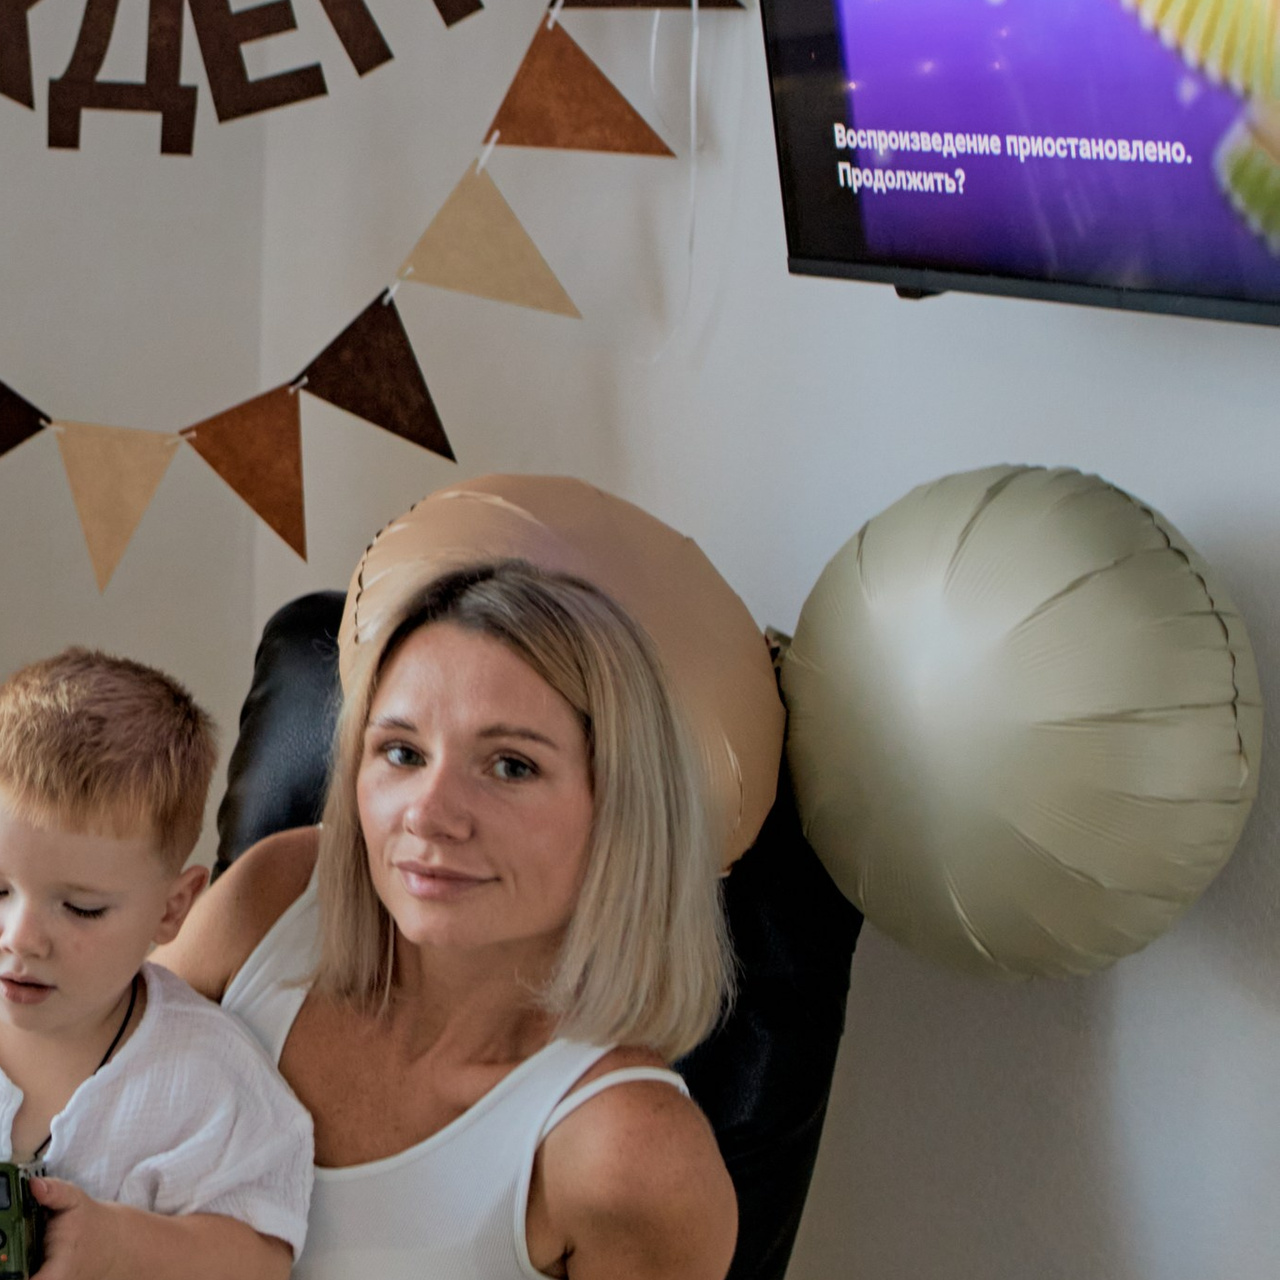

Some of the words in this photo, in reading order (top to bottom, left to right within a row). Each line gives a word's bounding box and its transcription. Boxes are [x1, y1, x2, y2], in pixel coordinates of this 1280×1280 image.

[833, 122, 1002, 159] Воспроизведение
[1006, 134, 1193, 165] приостановлено.
[837, 160, 966, 195] Продолжить?
